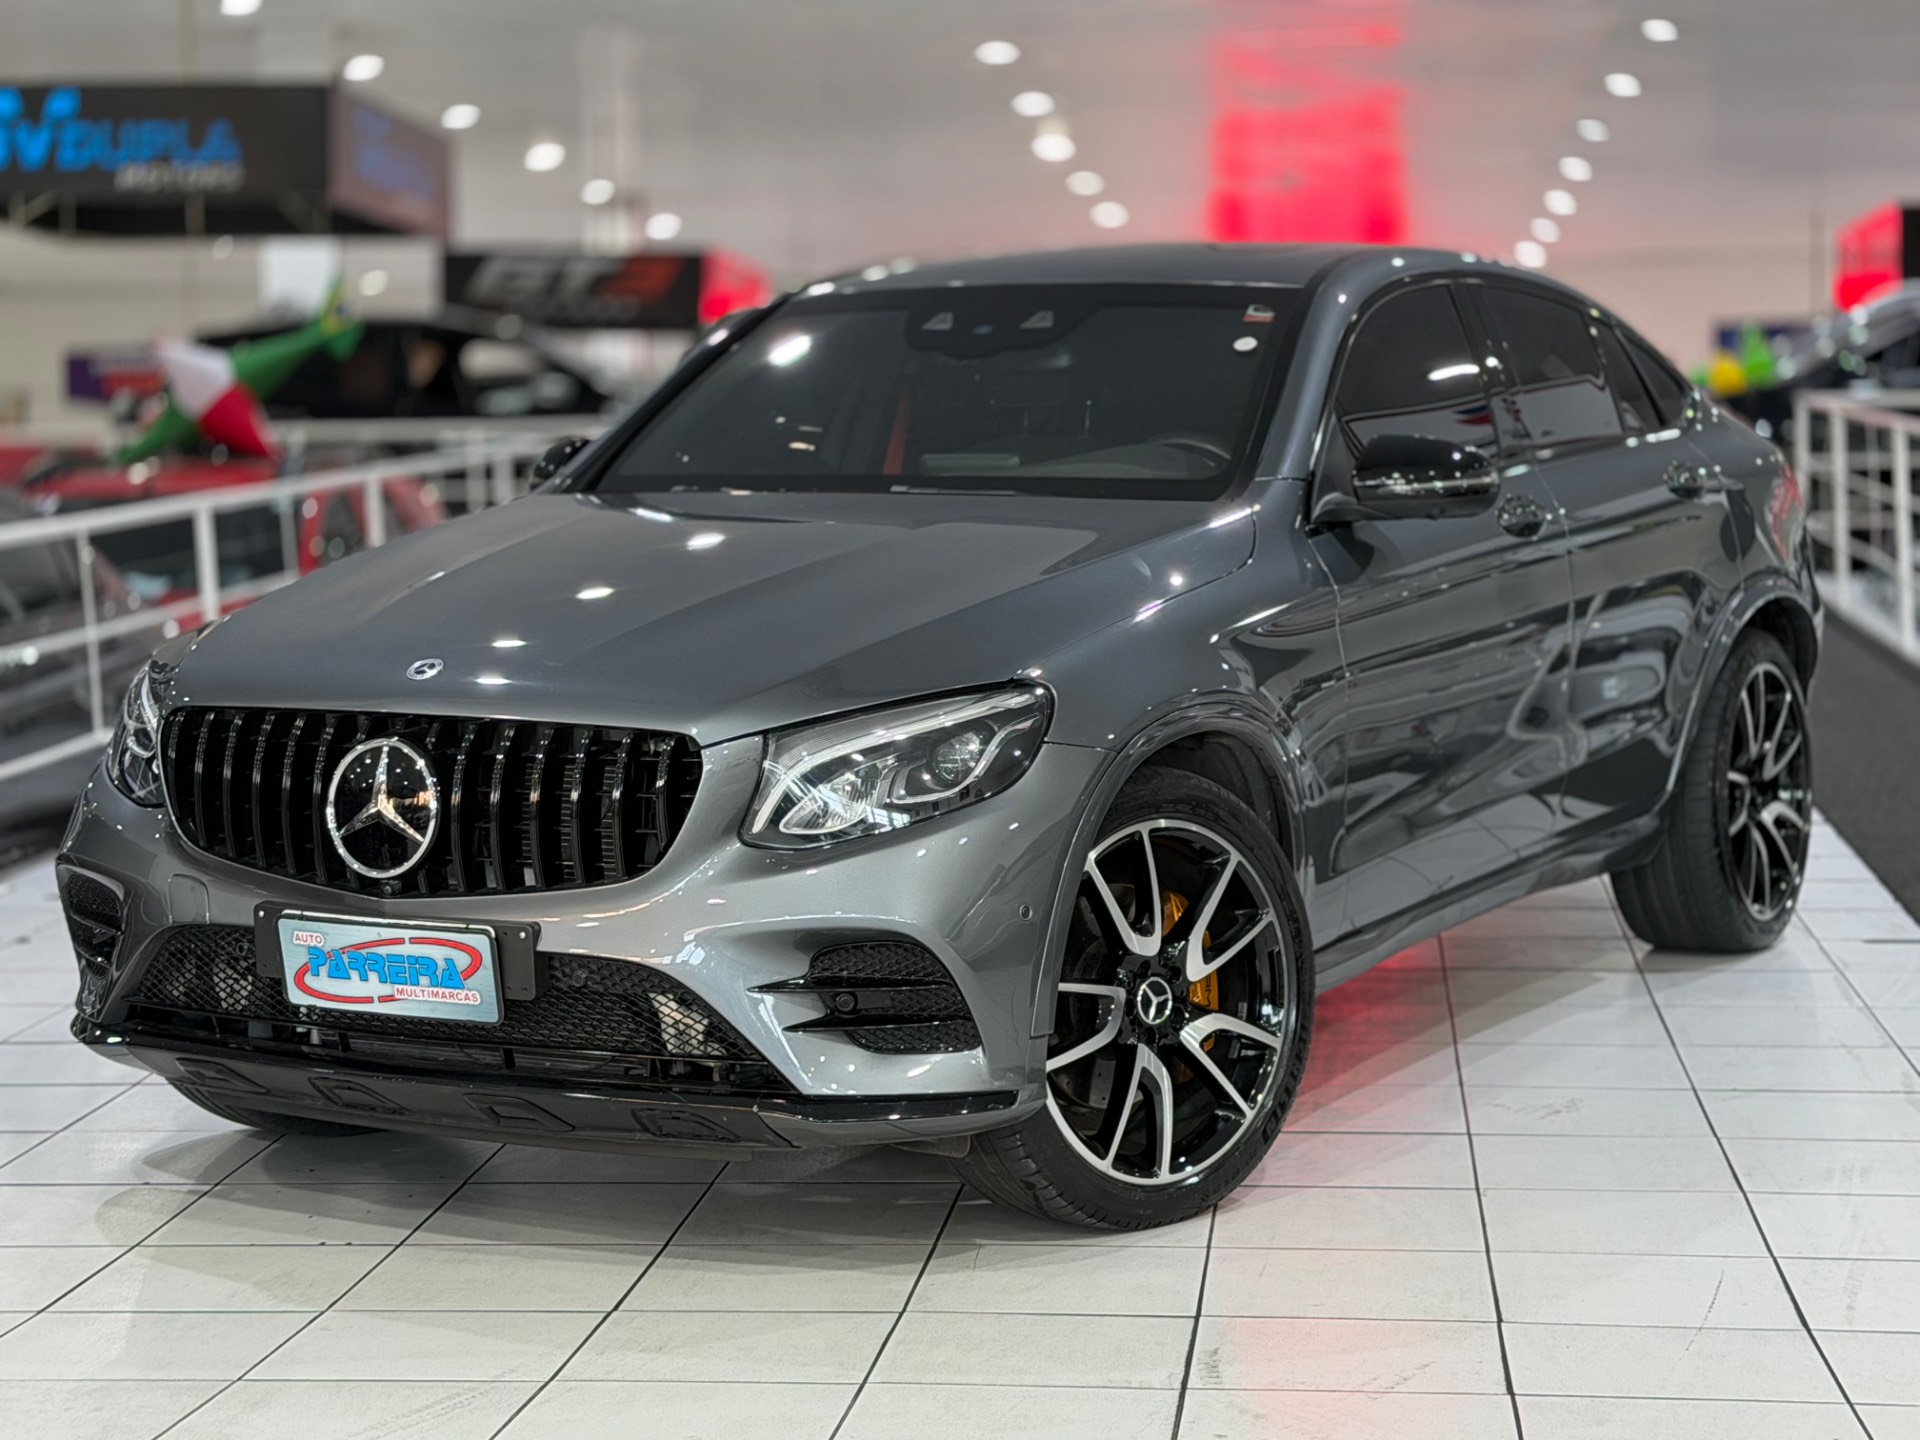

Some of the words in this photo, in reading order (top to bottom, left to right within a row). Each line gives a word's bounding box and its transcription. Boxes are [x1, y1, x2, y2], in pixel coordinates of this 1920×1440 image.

[294, 932, 323, 945] AUTO
[308, 947, 465, 989] PARREIRA
[396, 988, 479, 1002] MULTIMARCAS
